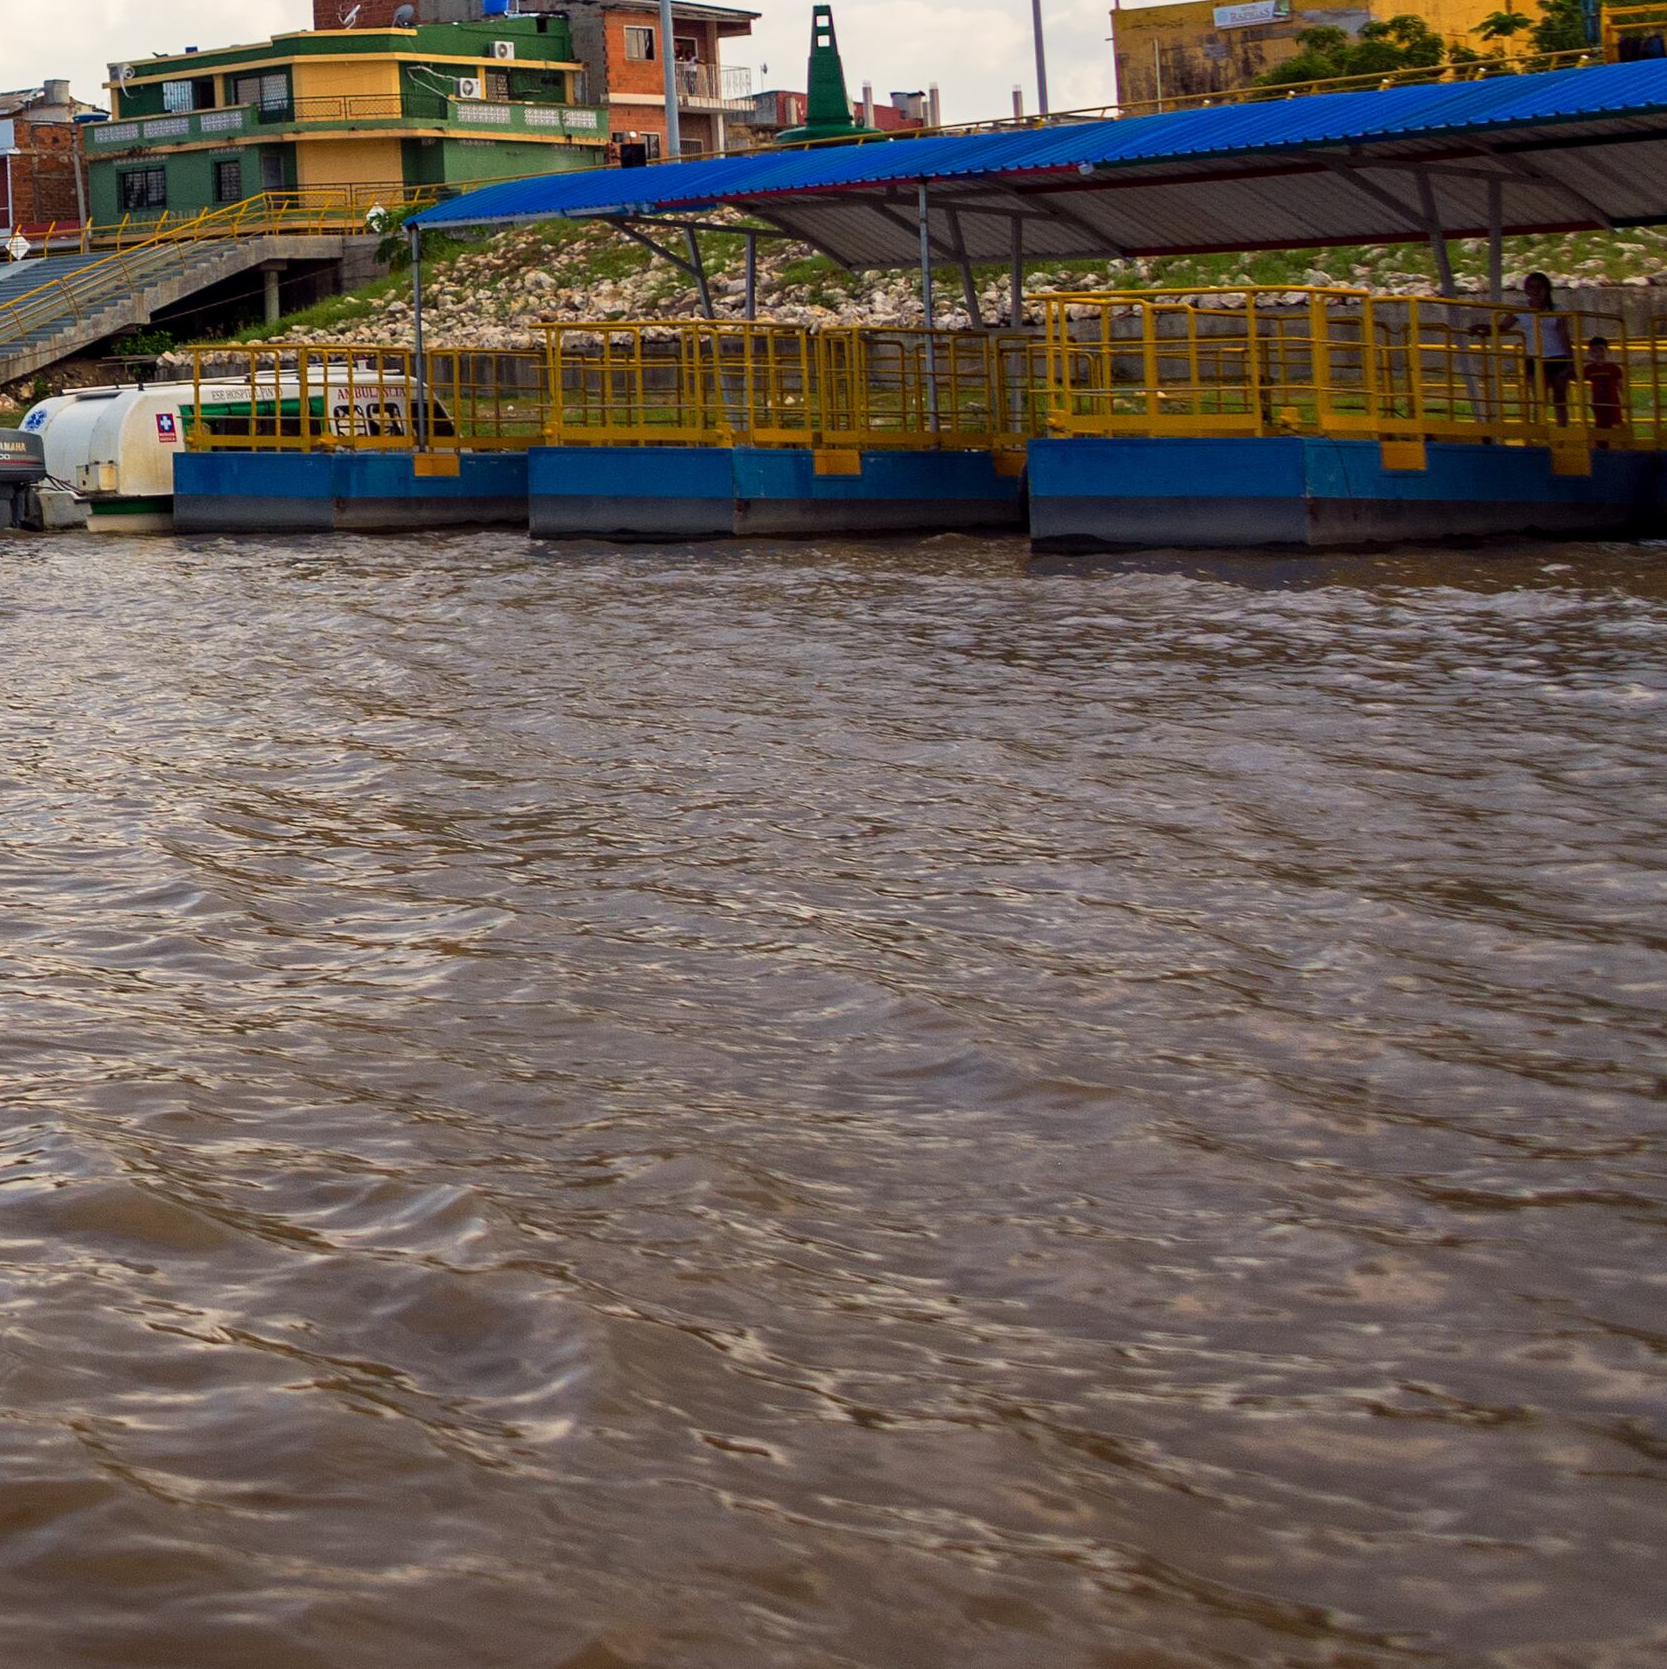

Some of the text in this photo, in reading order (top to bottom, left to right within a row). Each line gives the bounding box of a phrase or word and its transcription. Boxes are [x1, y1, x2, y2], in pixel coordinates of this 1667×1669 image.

[211, 389, 225, 401] ESE
[226, 387, 260, 400] HOSPITL
[337, 386, 407, 400] AMBULNCIA
